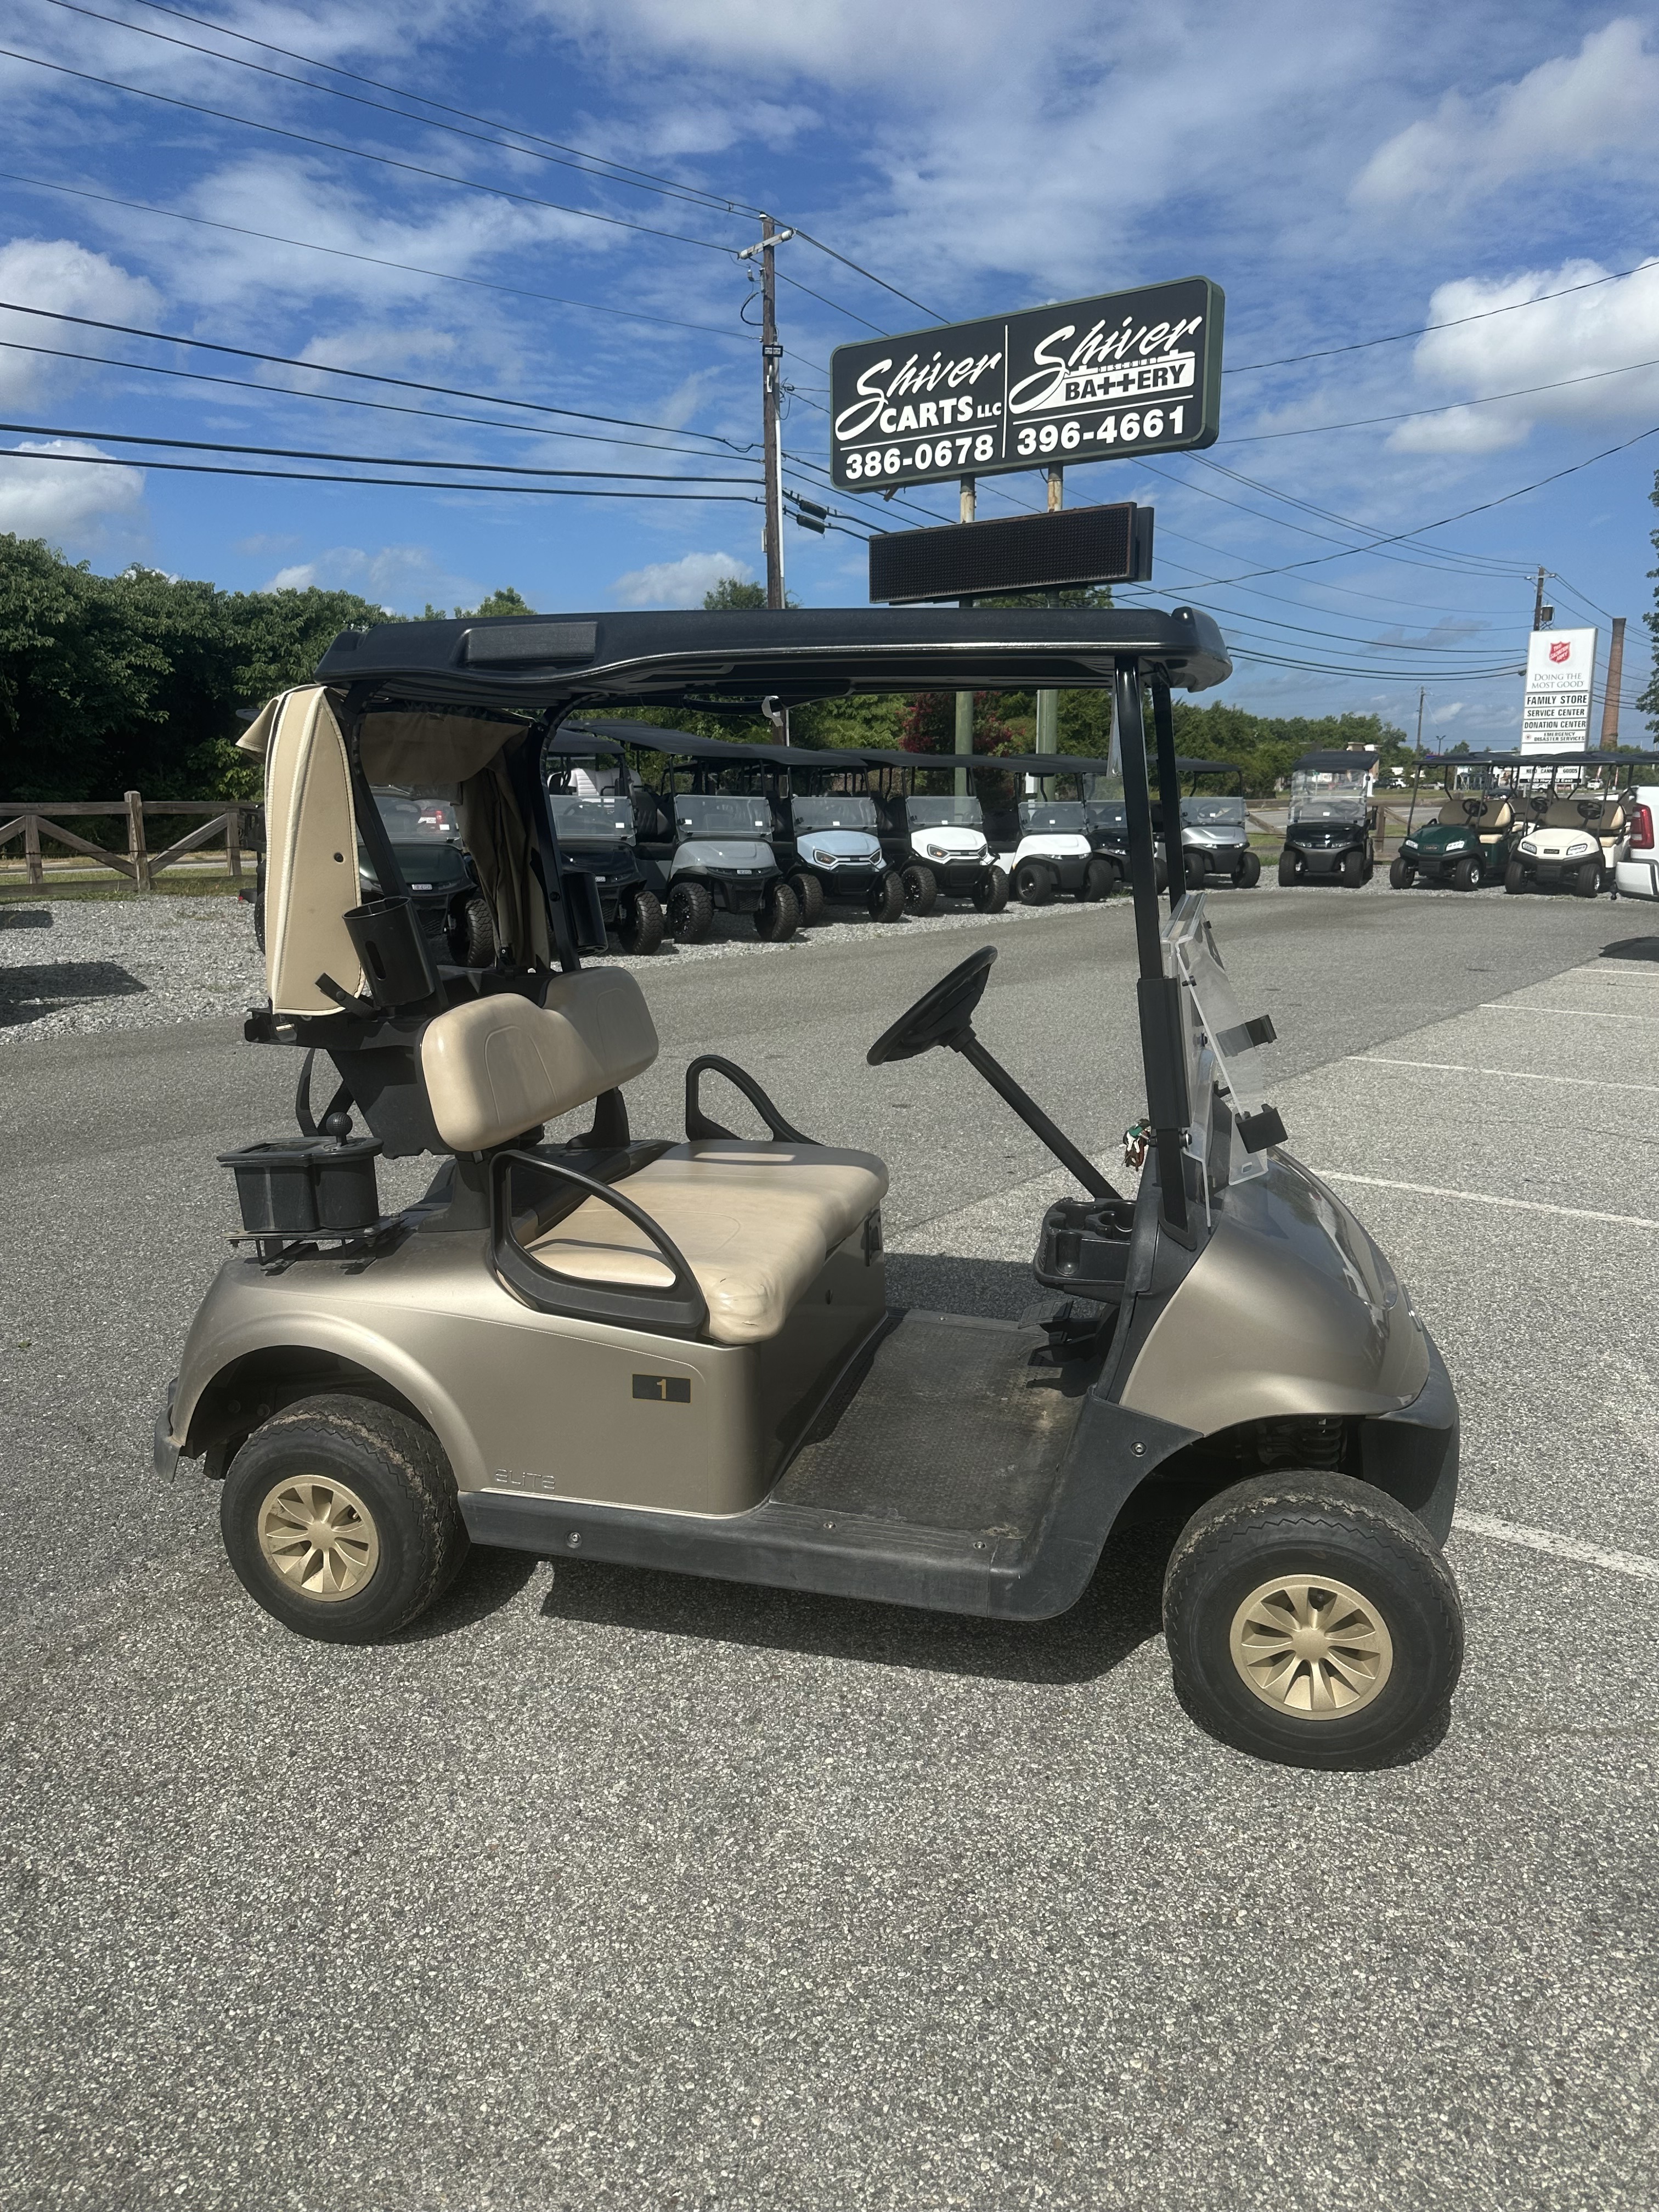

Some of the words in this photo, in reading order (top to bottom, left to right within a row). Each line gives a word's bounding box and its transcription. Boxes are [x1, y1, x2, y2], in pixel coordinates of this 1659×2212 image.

[1008, 316, 1203, 414] Shiver
[1097, 357, 1159, 374] DISCOUNT
[834, 351, 1002, 441] Shiver
[879, 396, 974, 433] CARTS
[977, 402, 1002, 419] LLC
[1017, 405, 1184, 456] 396-4661
[845, 434, 994, 479] 386-0678
[1534, 673, 1564, 681] DOING
[1527, 696, 1557, 705] FAMILY
[1560, 695, 1587, 704] STORE
[1527, 709, 1555, 717] SERVICE
[1524, 721, 1558, 729] DONATION
[656, 1379, 667, 1399] 1
